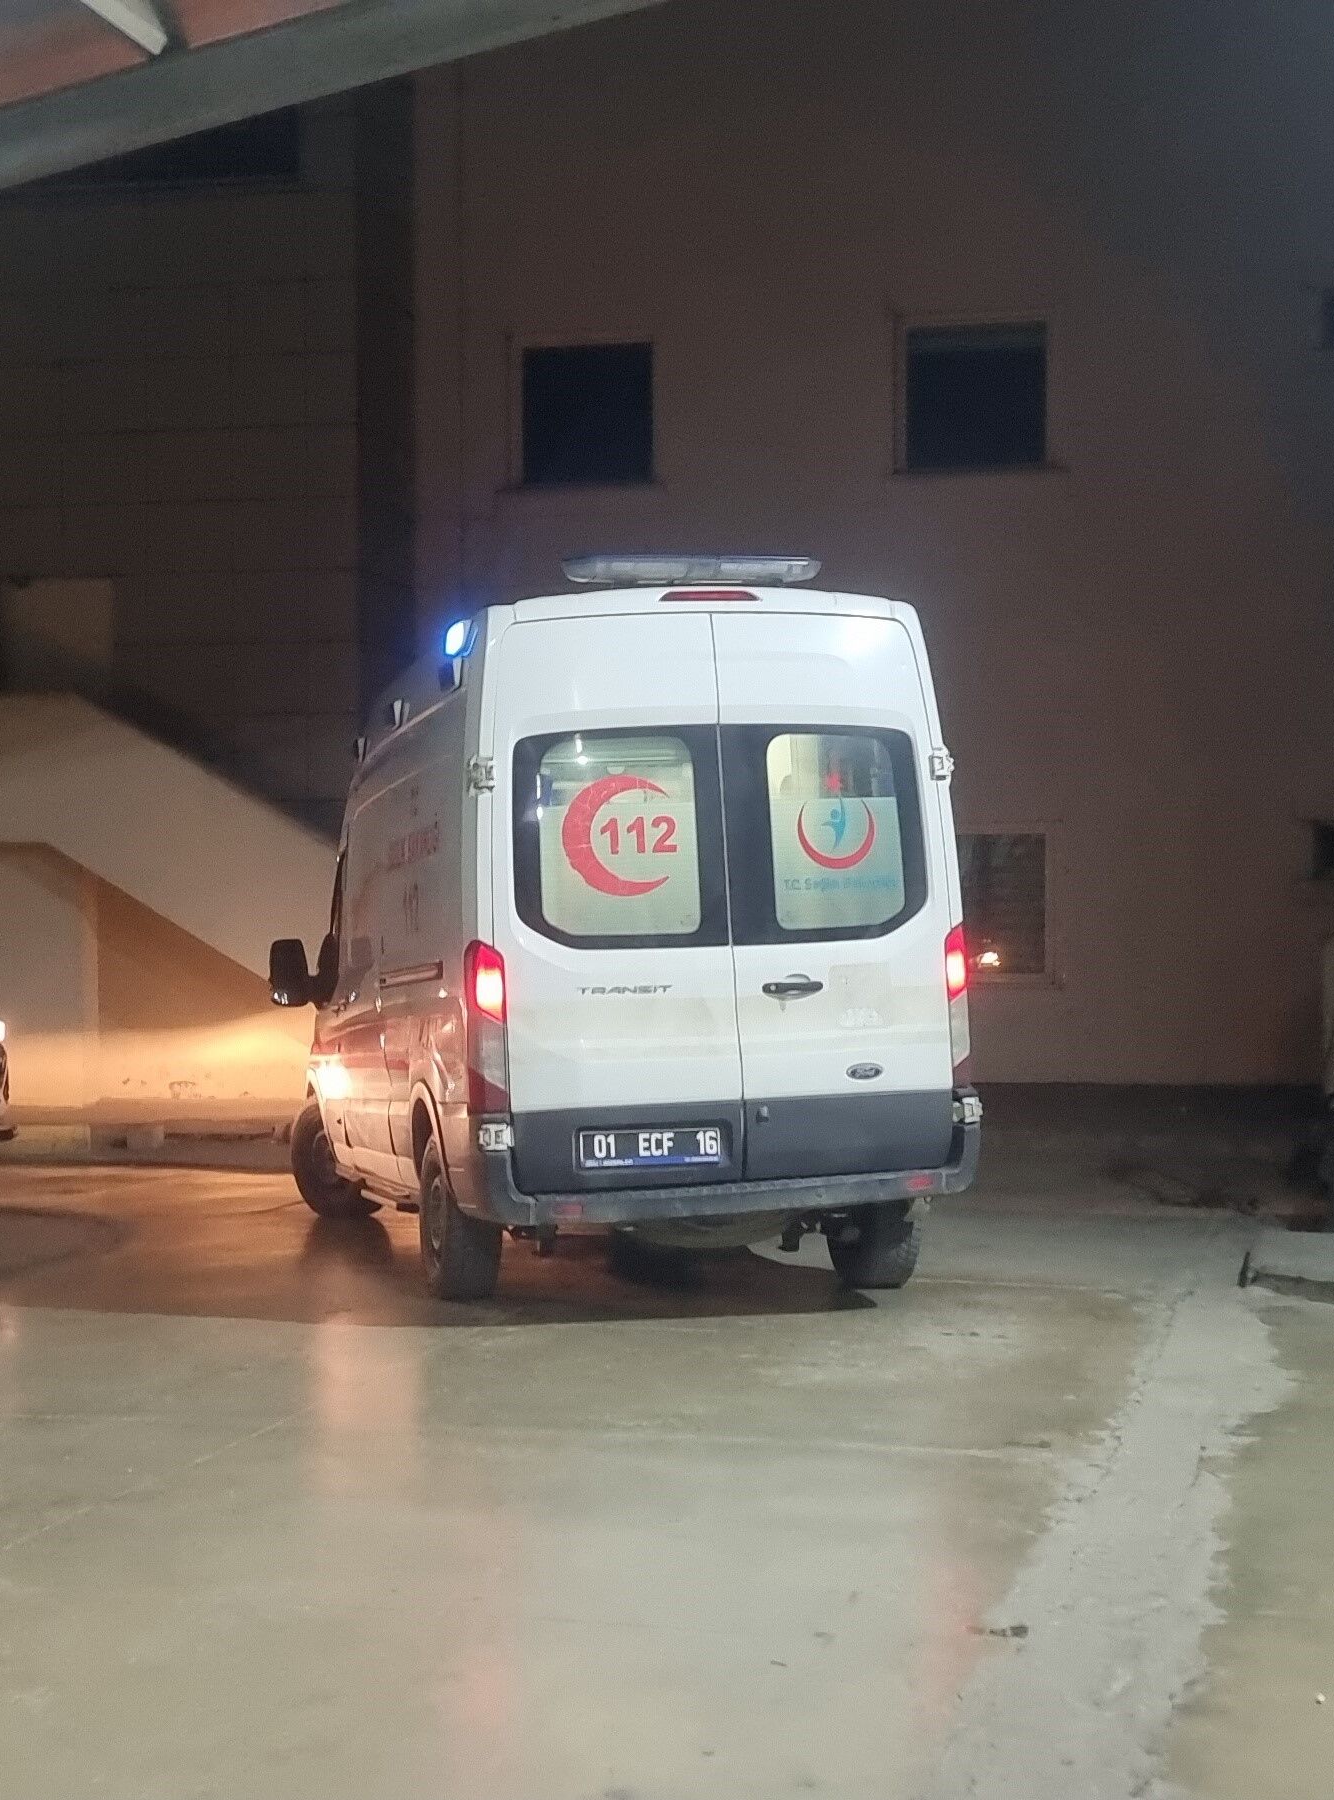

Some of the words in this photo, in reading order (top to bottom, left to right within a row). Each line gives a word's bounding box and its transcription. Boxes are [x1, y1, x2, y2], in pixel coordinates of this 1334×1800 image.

[600, 815, 679, 855] 112
[593, 1133, 616, 1159] 01
[638, 1132, 675, 1157] ECF
[696, 1130, 718, 1155] 16
